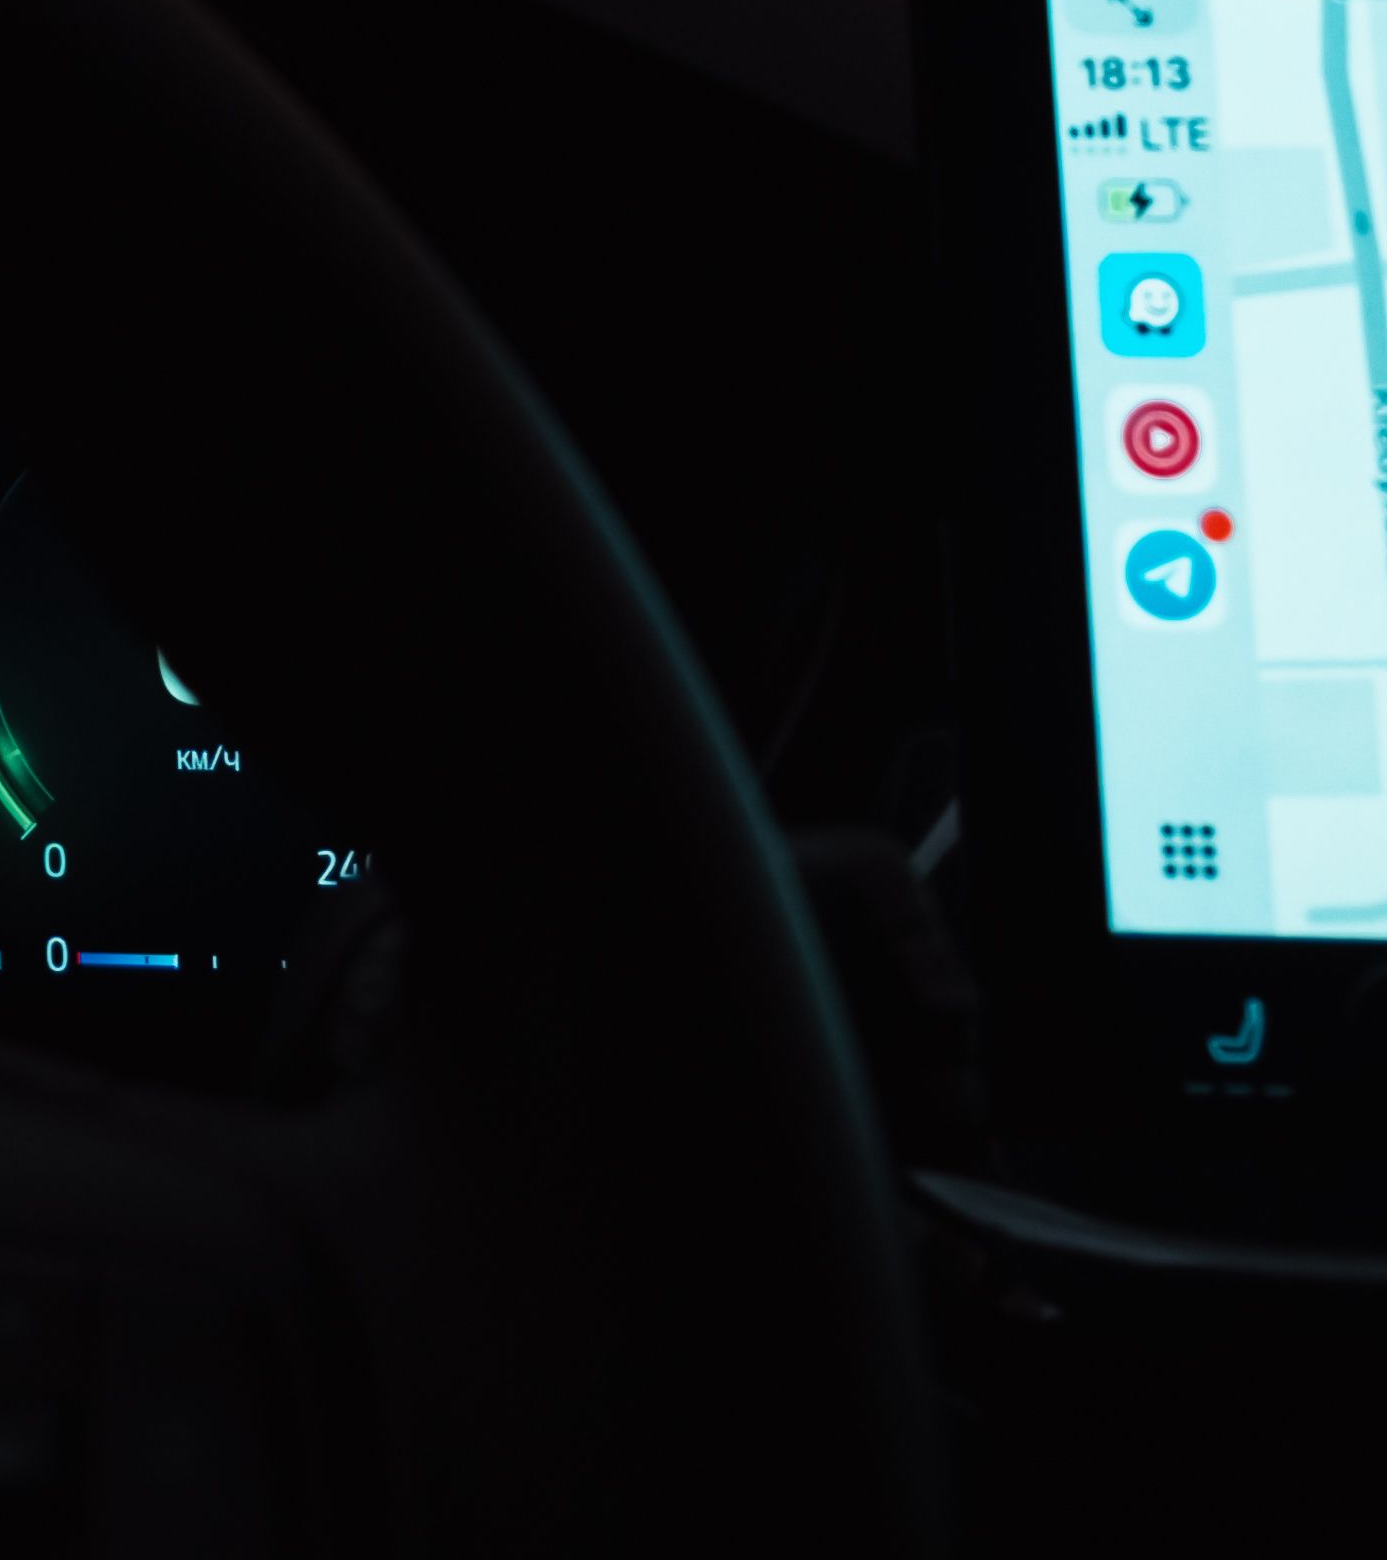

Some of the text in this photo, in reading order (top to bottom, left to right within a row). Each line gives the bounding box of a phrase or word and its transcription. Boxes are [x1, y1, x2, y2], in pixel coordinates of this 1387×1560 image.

[1081, 55, 1192, 92] 18:13
[1140, 116, 1211, 152] LTE
[43, 842, 67, 878] 0
[46, 935, 69, 972] 0
